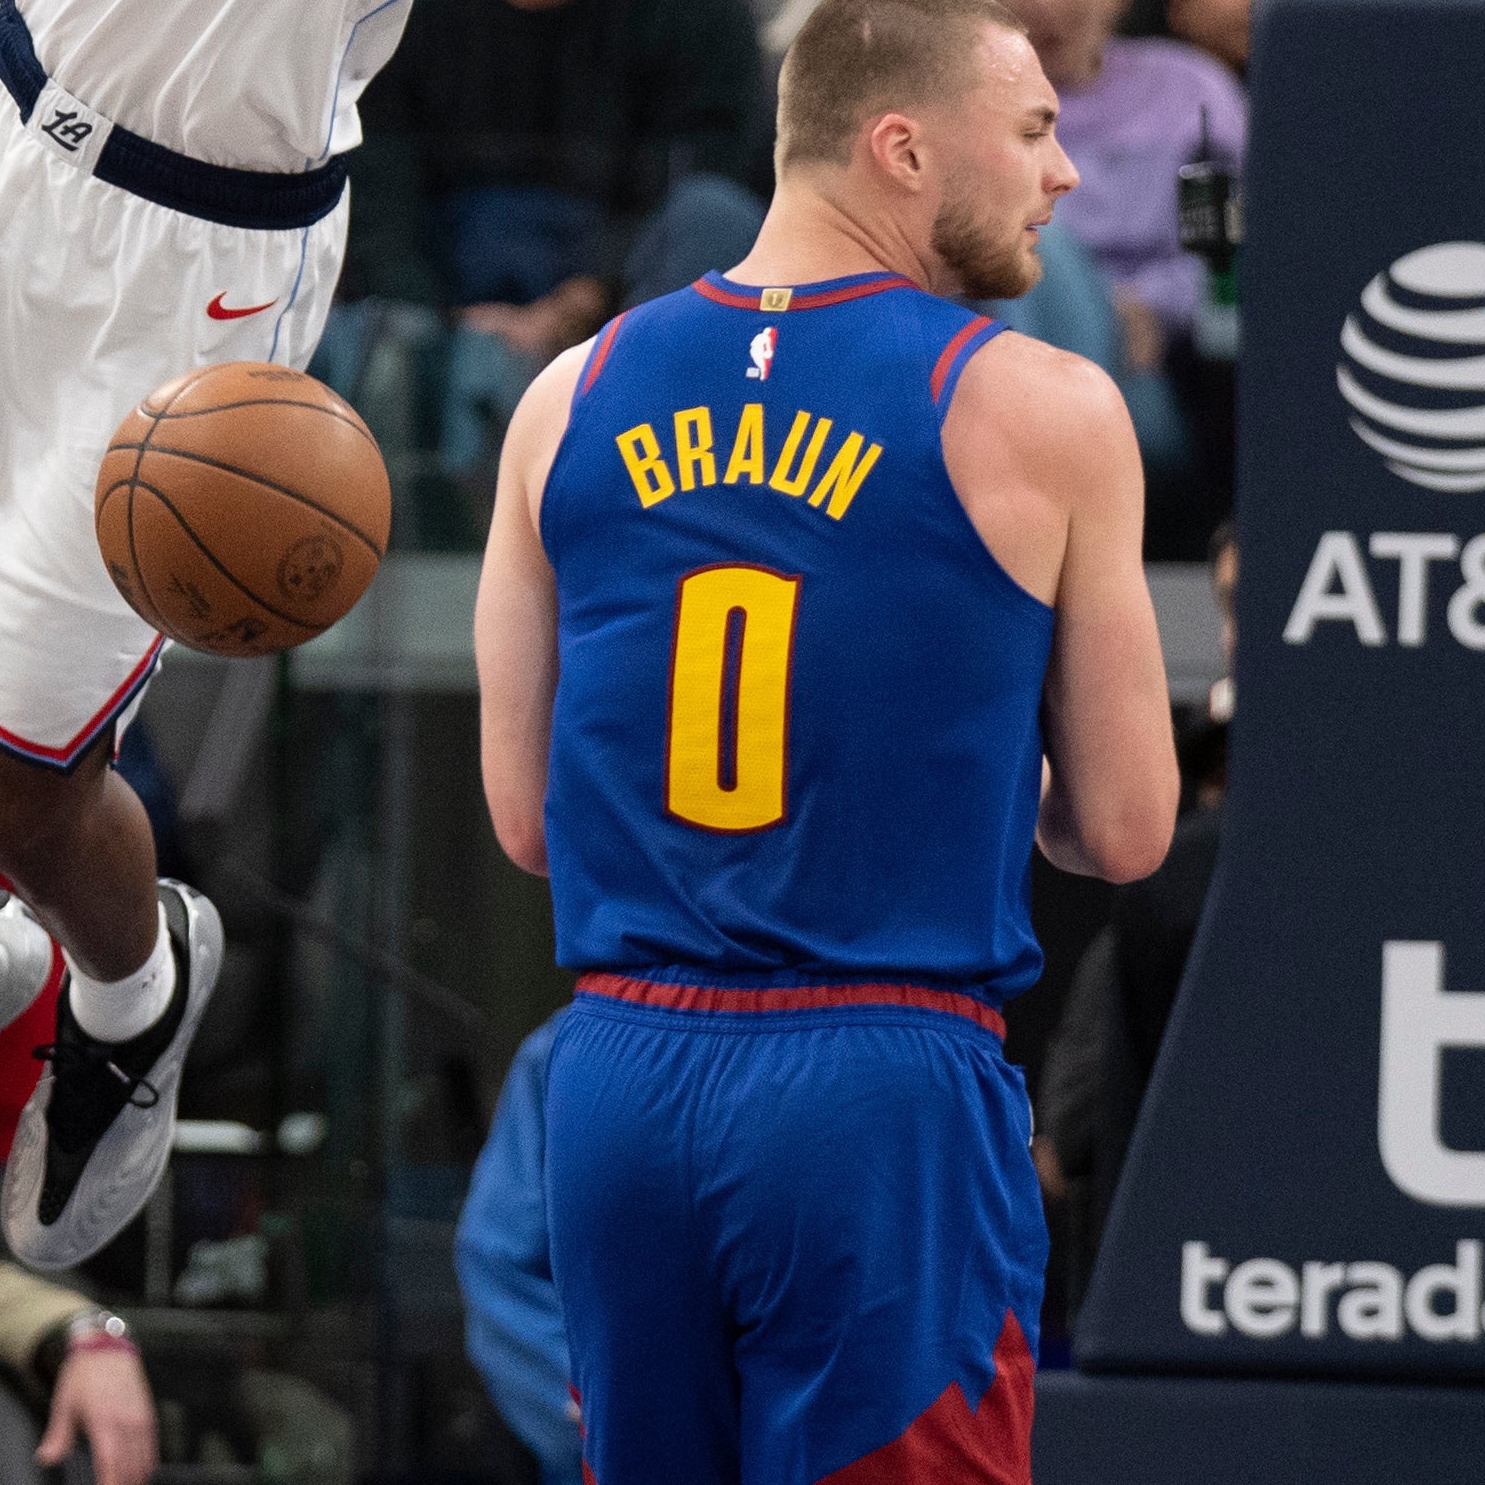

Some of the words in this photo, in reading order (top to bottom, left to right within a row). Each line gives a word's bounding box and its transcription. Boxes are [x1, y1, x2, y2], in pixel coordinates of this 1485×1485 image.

[41, 108, 93, 152] LA
[615, 402, 883, 521] BRAUN
[663, 560, 803, 835] 0
